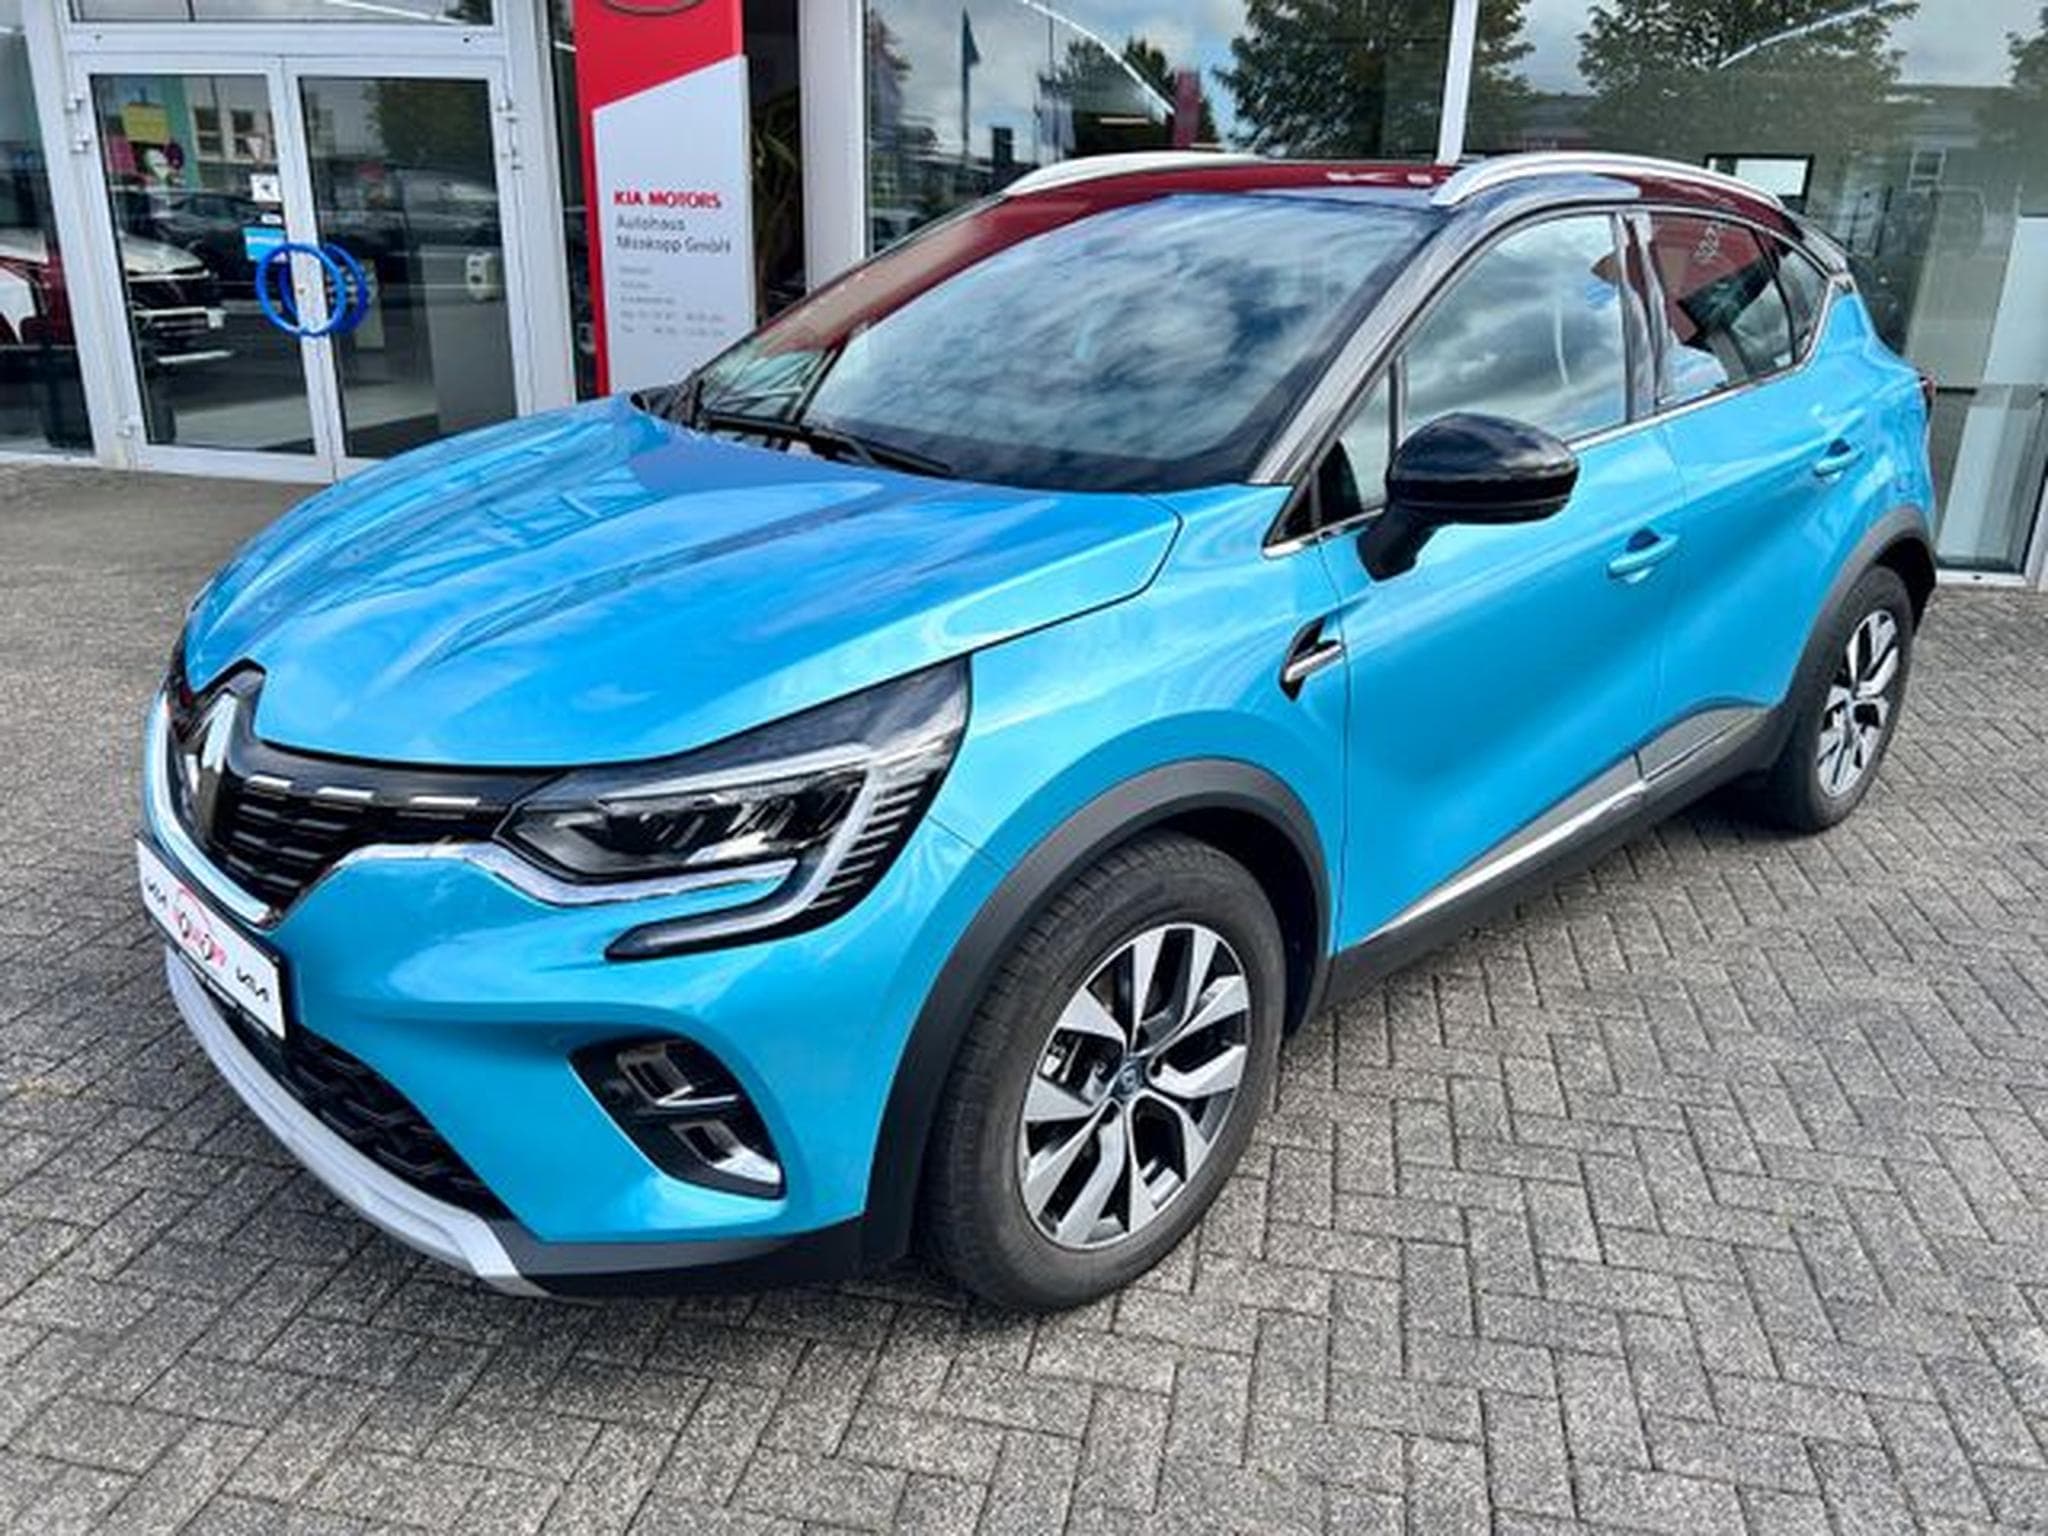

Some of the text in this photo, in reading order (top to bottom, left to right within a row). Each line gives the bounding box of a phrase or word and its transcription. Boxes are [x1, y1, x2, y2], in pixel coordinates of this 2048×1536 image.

[613, 190, 722, 209] KIA MOTORS
[617, 214, 686, 231] Autohaus
[684, 235, 731, 253] GmbH
